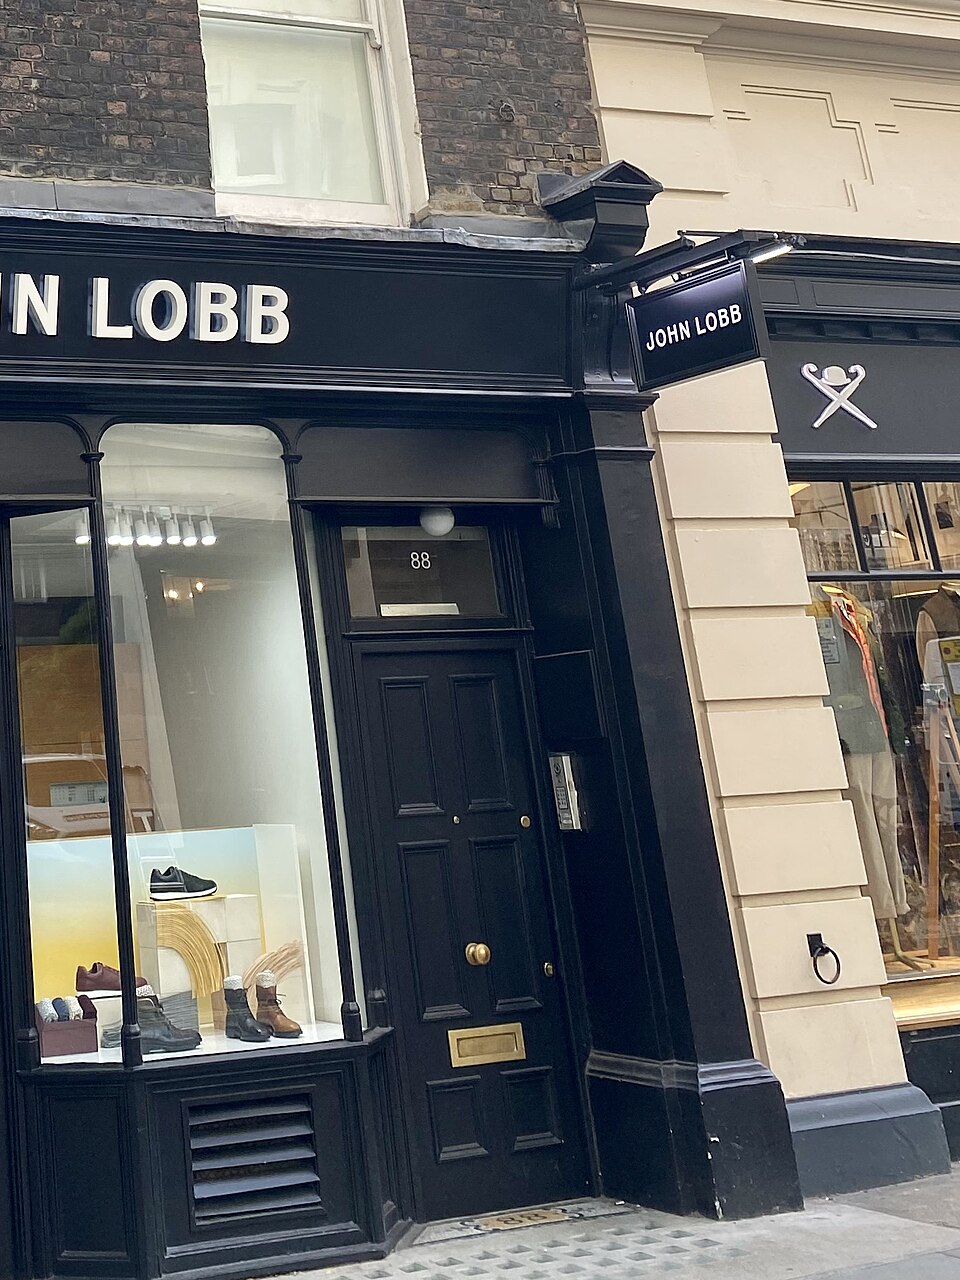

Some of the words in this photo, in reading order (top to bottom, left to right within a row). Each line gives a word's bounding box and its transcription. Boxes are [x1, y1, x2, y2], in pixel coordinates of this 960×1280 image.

[88, 277, 290, 344] LOBB
[646, 320, 691, 351] JOHN
[694, 304, 742, 335] LOBB
[410, 551, 431, 569] 88
